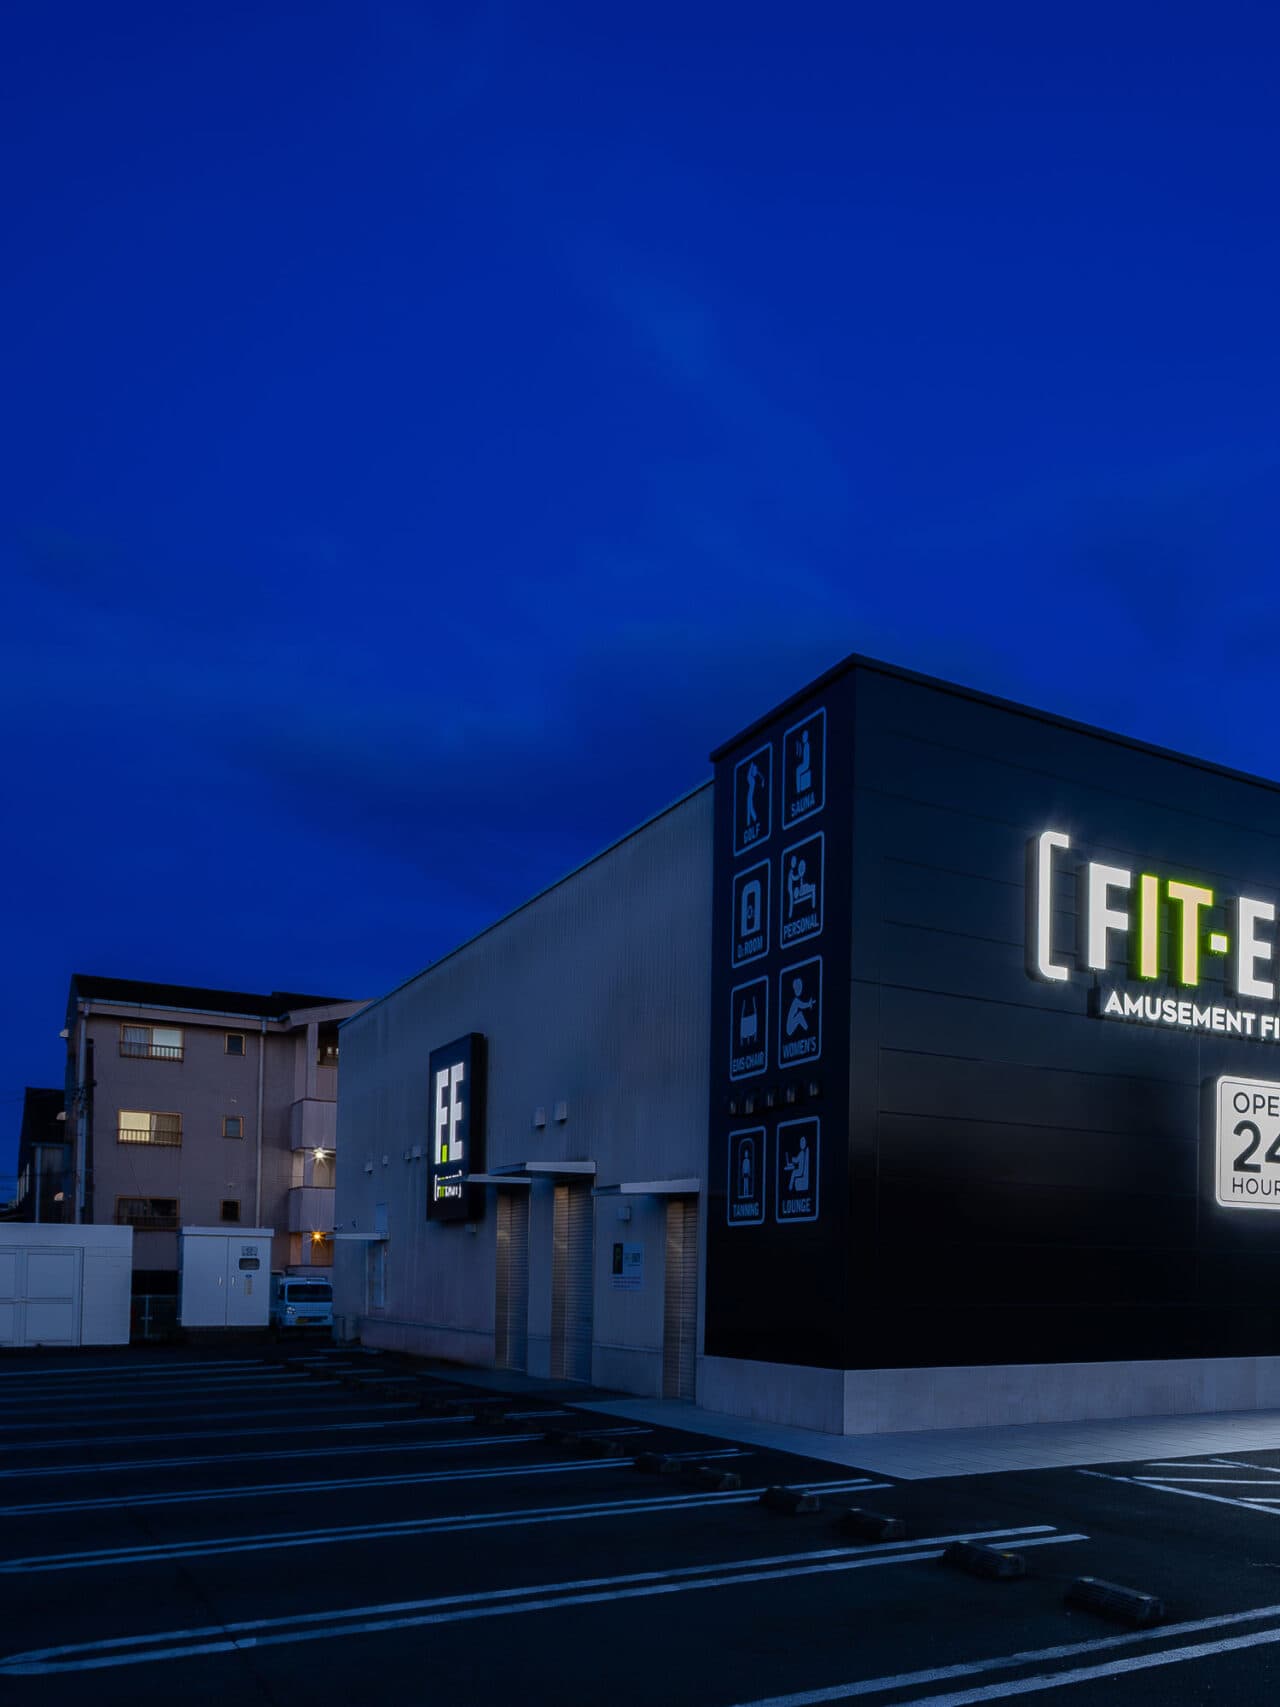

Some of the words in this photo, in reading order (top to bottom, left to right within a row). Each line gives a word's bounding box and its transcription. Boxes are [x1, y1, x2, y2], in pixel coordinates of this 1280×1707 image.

[783, 912, 820, 940] PERSONAL
[1103, 991, 1256, 1036] AMUSEMENT
[782, 1197, 811, 1214] LOUNGE
